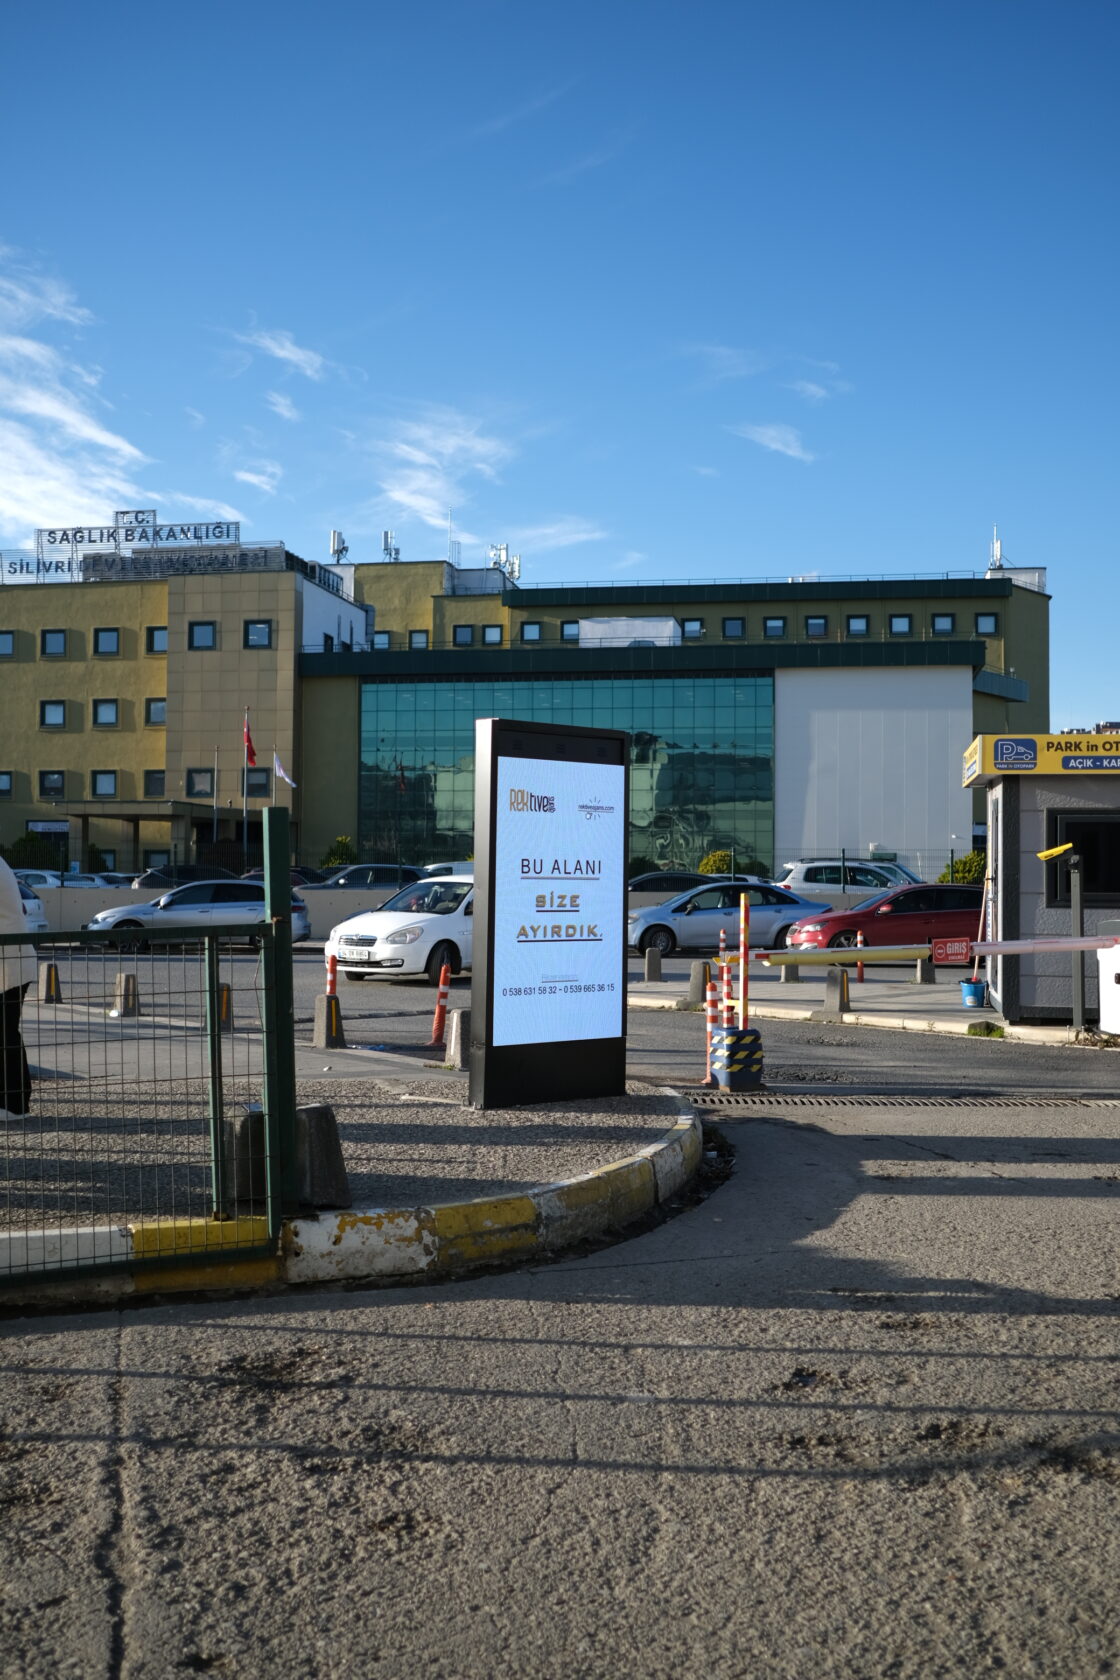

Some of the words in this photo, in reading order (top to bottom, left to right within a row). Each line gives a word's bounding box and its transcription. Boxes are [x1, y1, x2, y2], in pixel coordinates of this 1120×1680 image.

[47, 526, 117, 544] SAĞLIK
[125, 521, 230, 542] BAKANLIĞI
[1046, 741, 1083, 752] PARK
[1087, 741, 1098, 752] in
[1069, 759, 1093, 769] AÇIK
[521, 859, 543, 874] BU
[551, 859, 601, 875] ALANI
[535, 891, 580, 907] SİZE
[502, 988, 508, 997] 0
[509, 988, 521, 996] 538
[523, 987, 536, 996] 631
[538, 986, 547, 995] 58
[548, 985, 557, 994] 32
[563, 985, 569, 993] 0
[569, 985, 582, 993] 539
[583, 984, 596, 992] 665
[607, 983, 615, 992] 15
